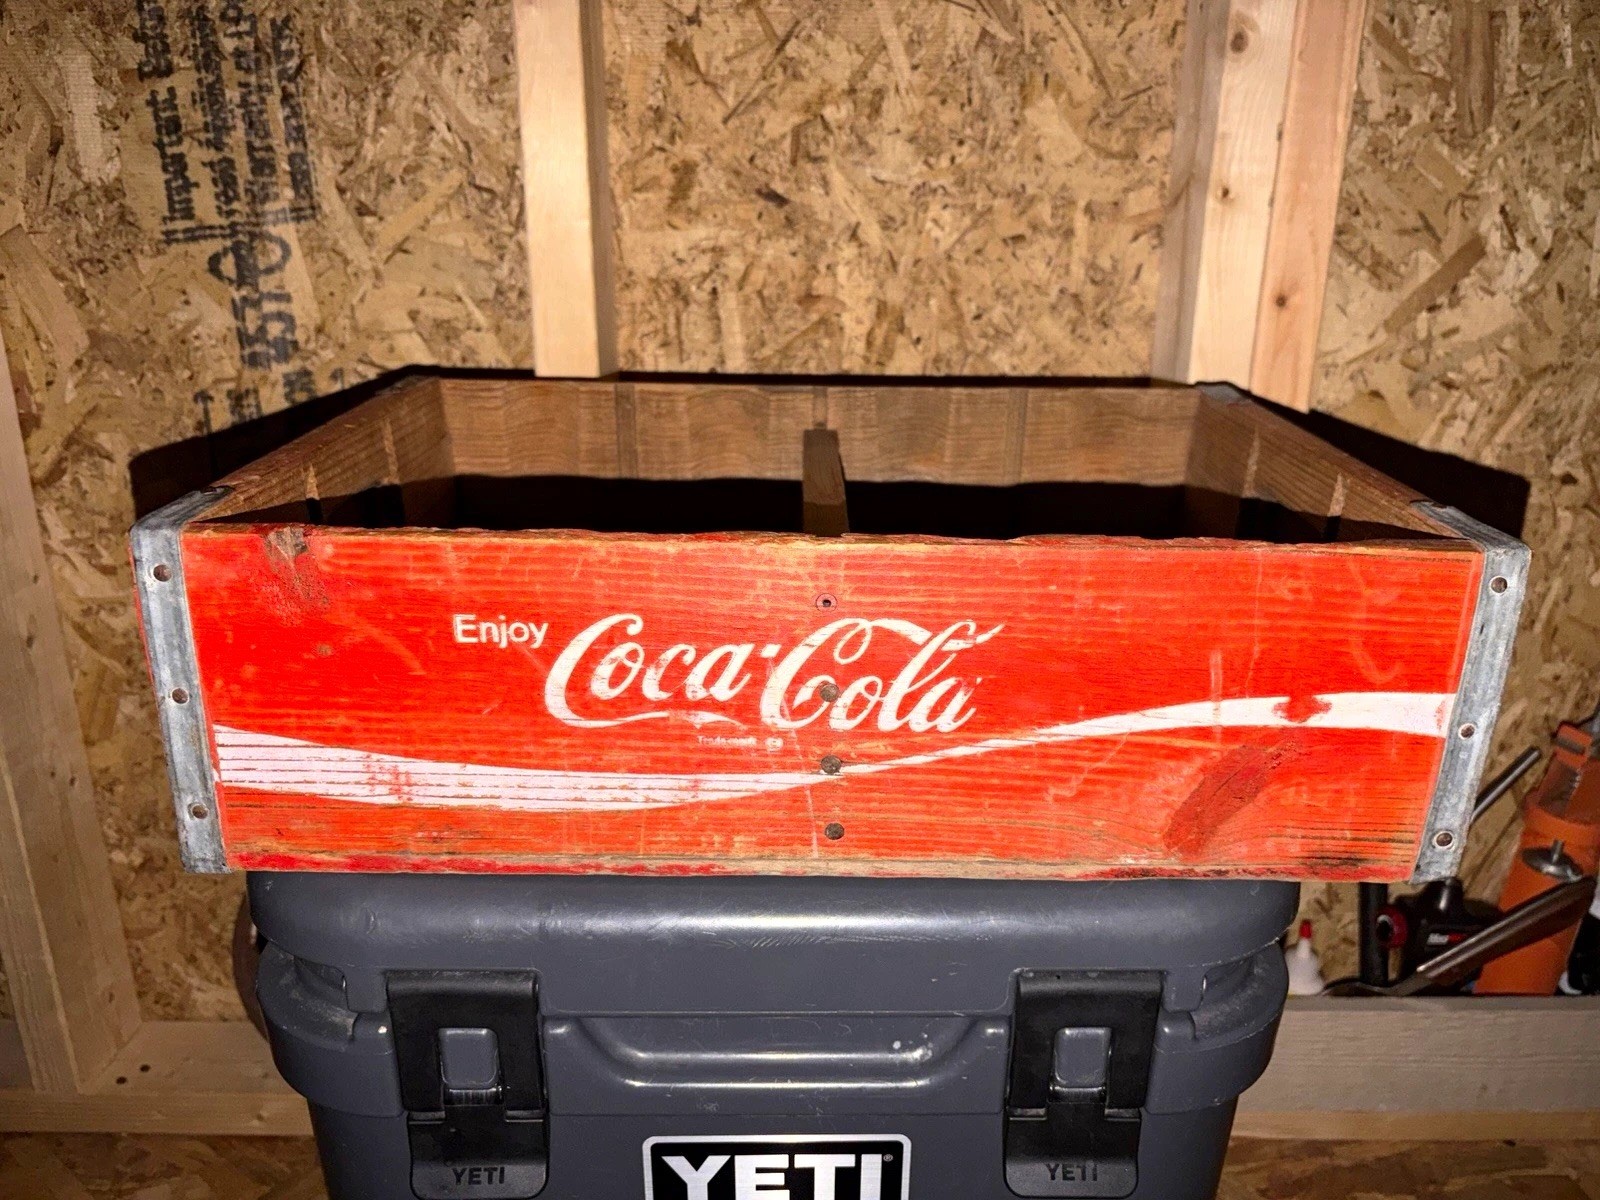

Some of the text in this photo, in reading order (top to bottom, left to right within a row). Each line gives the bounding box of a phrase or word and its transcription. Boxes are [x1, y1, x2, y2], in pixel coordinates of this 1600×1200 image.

[452, 613, 548, 649] Enjoy
[545, 613, 1005, 733] Coca-Cola
[452, 1166, 505, 1185] YETI
[661, 1154, 884, 1200] YETI
[1045, 1163, 1098, 1181] YETI
